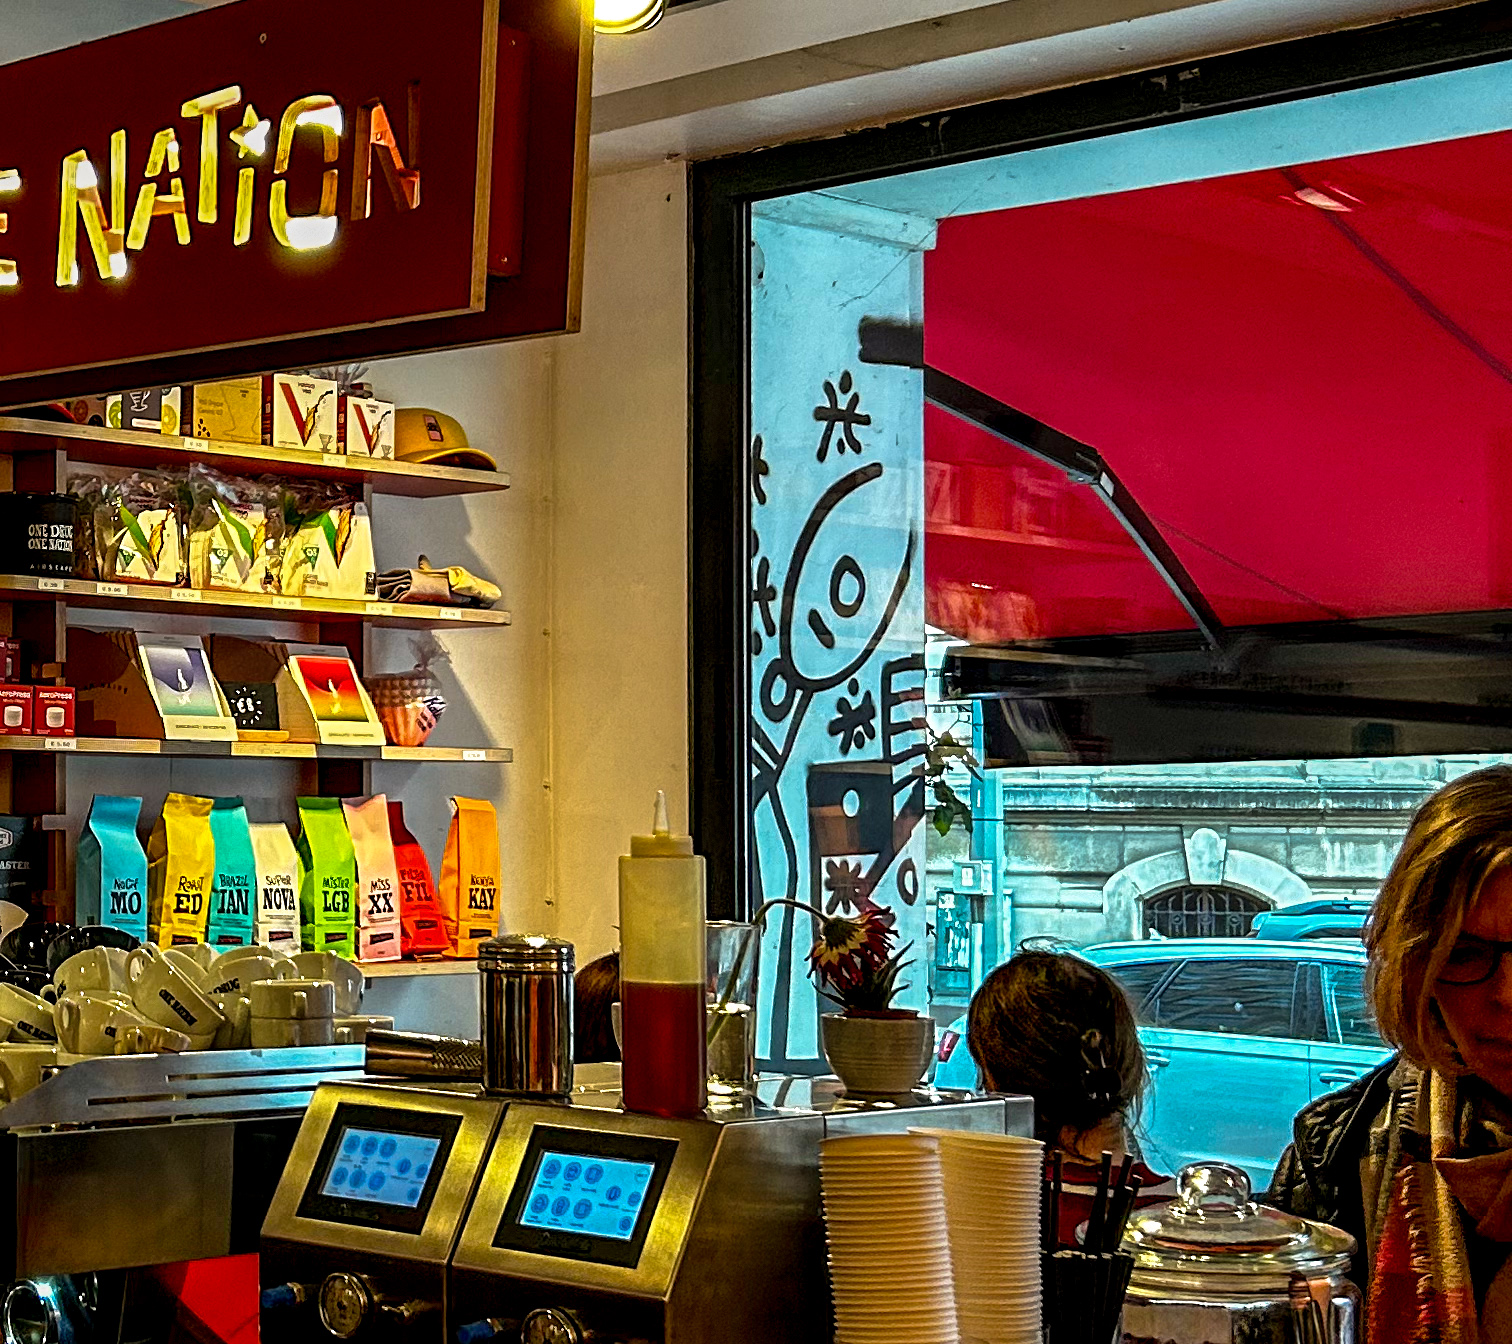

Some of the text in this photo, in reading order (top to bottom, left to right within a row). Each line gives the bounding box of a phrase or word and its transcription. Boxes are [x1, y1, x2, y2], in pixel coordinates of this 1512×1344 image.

[28, 523, 48, 538] ONE
[27, 537, 48, 550] ONE
[109, 890, 142, 915] MO
[217, 888, 250, 916] IAN
[262, 888, 296, 911] NOVA
[321, 889, 350, 913] LGB
[367, 892, 395, 915] XX
[401, 881, 433, 903] FIL
[467, 887, 497, 911] KAY
[173, 893, 203, 915] ED
